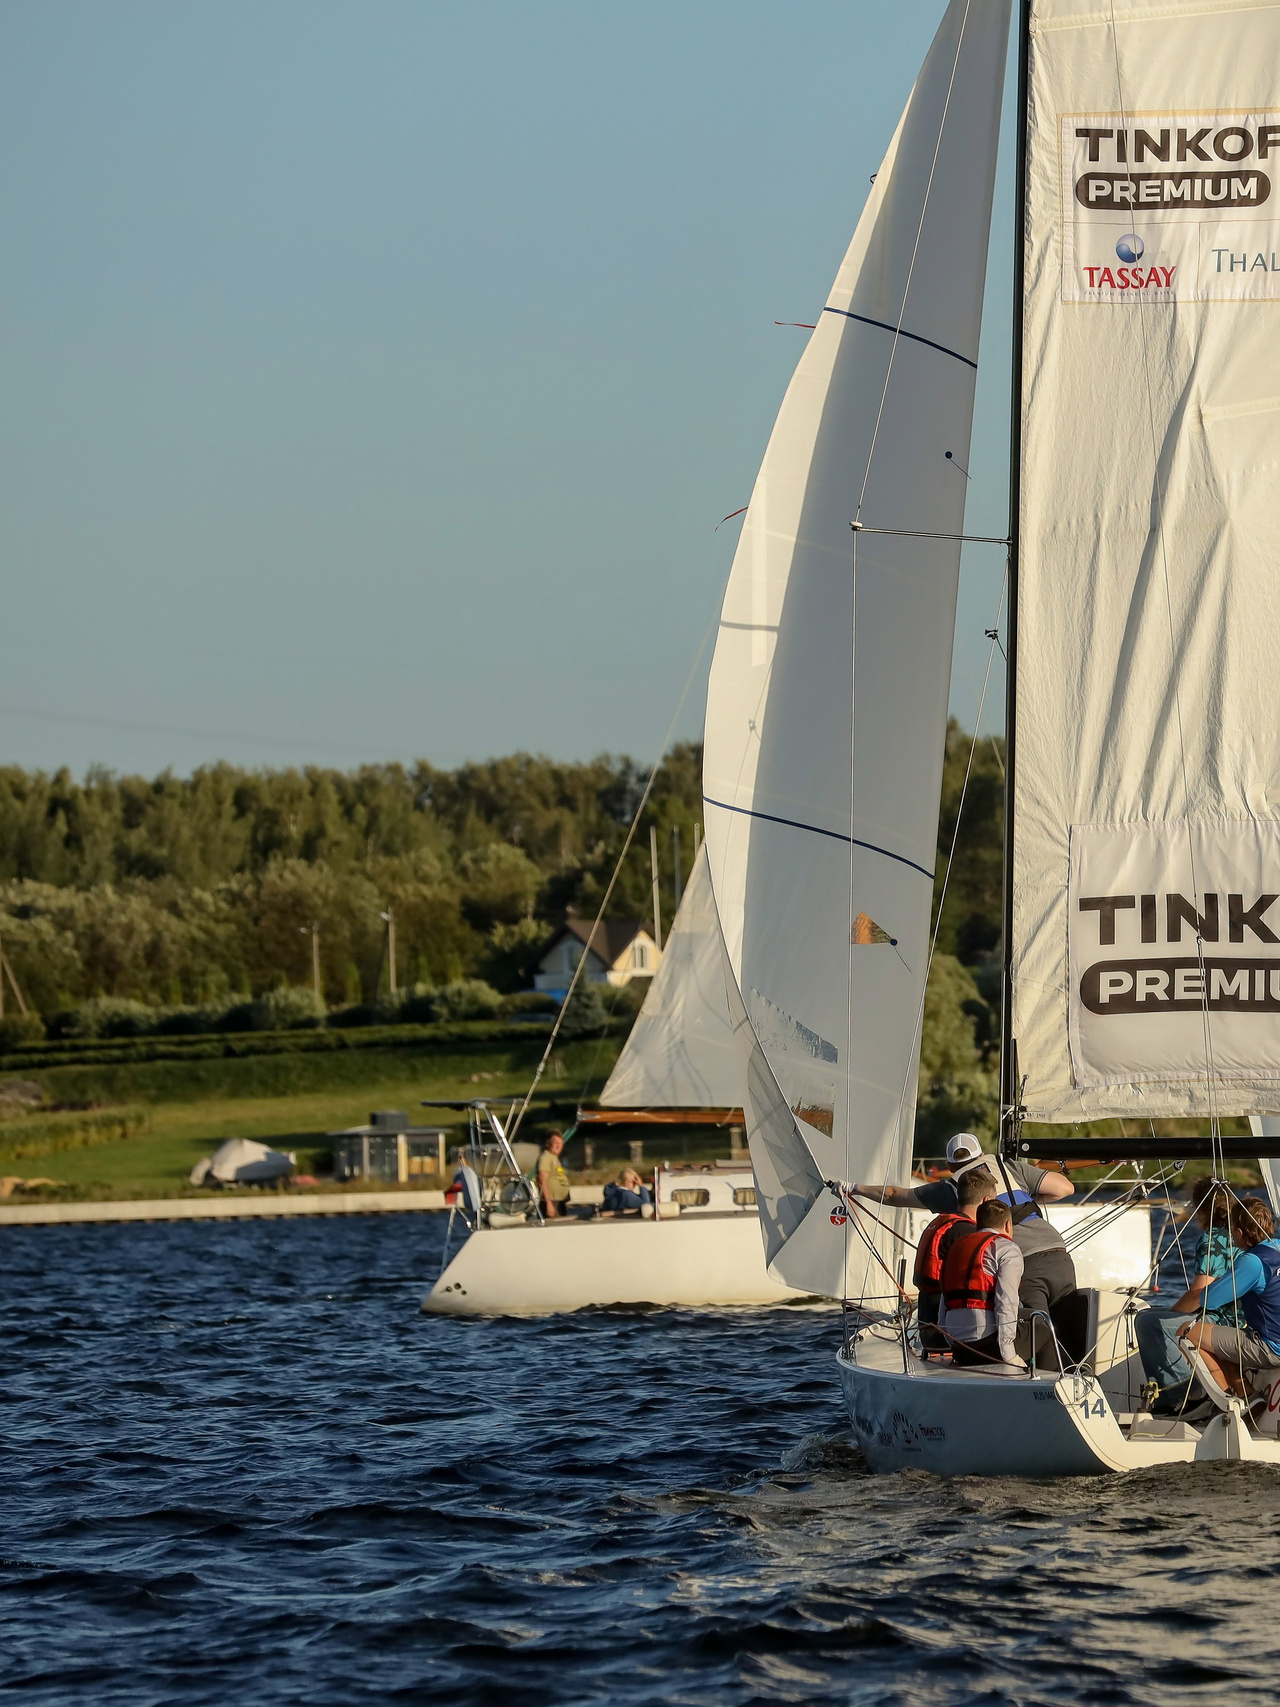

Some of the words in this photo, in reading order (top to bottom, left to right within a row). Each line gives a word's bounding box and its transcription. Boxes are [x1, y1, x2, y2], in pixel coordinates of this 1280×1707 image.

[1087, 177, 1258, 203] PREMIUM
[1083, 266, 1176, 289] TASSAY
[1079, 1398, 1107, 1419] 14
